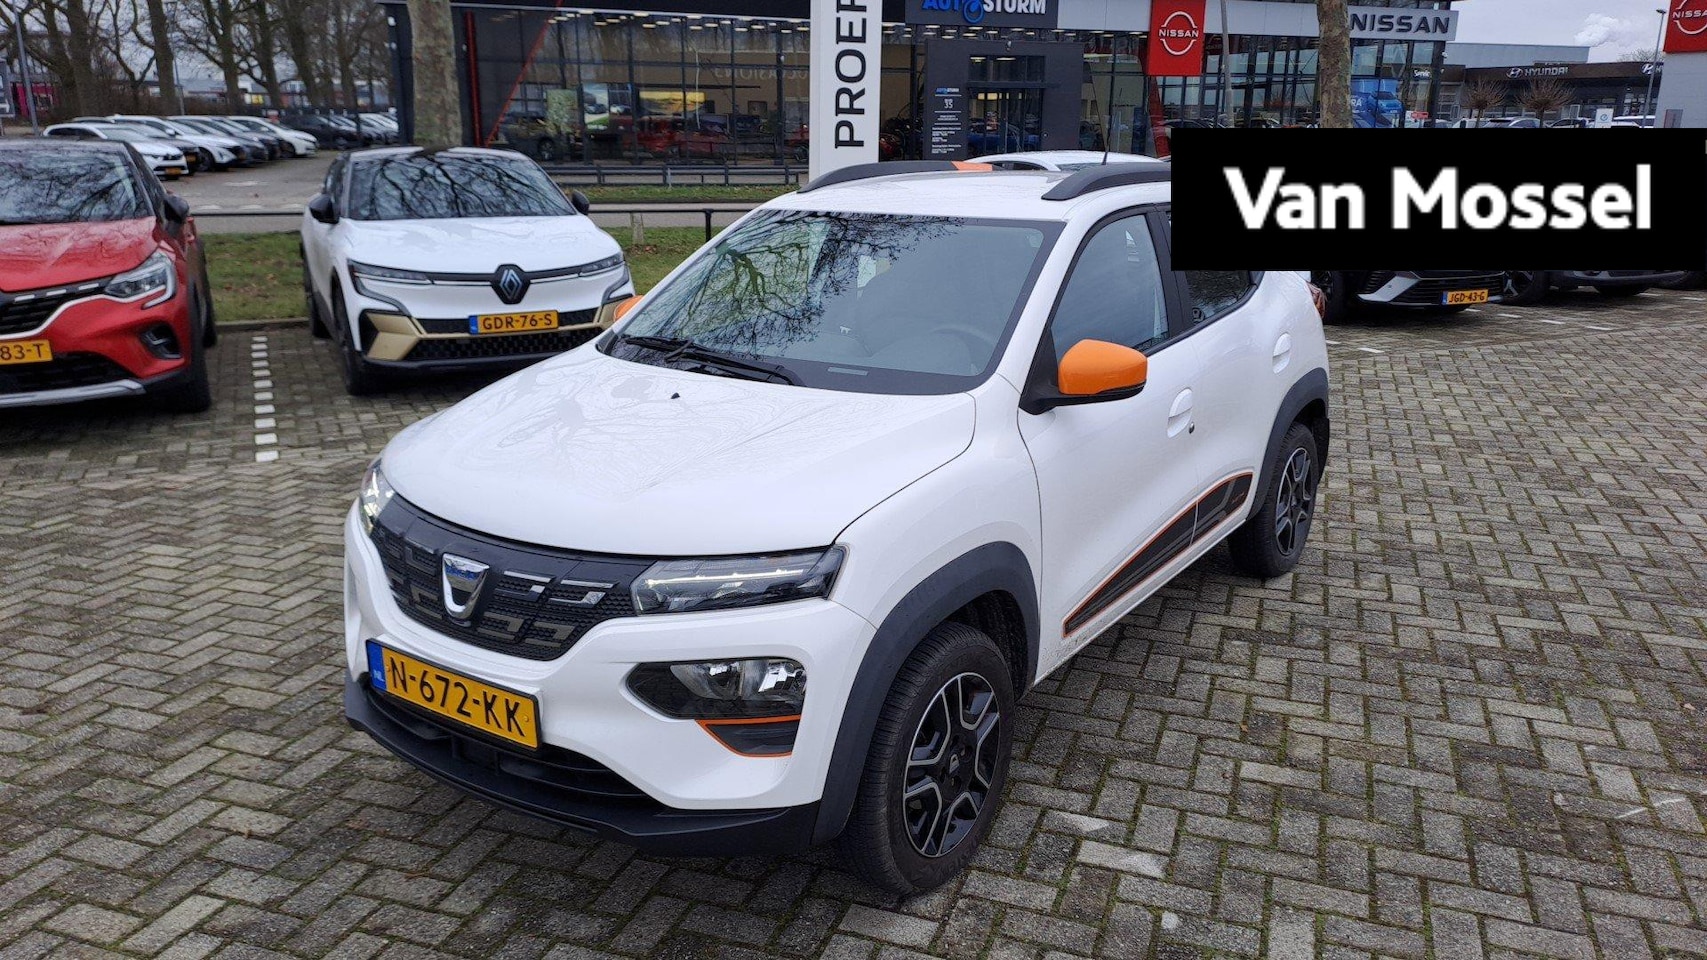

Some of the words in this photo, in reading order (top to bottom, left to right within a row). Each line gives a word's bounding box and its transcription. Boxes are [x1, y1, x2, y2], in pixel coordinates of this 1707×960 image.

[1350, 13, 1450, 34] NISSAN
[1158, 28, 1199, 38] NISSAN
[1448, 291, 1485, 303] JGD-43-G
[482, 313, 552, 330] GDR-76-S
[390, 656, 526, 738] N-672-KK
